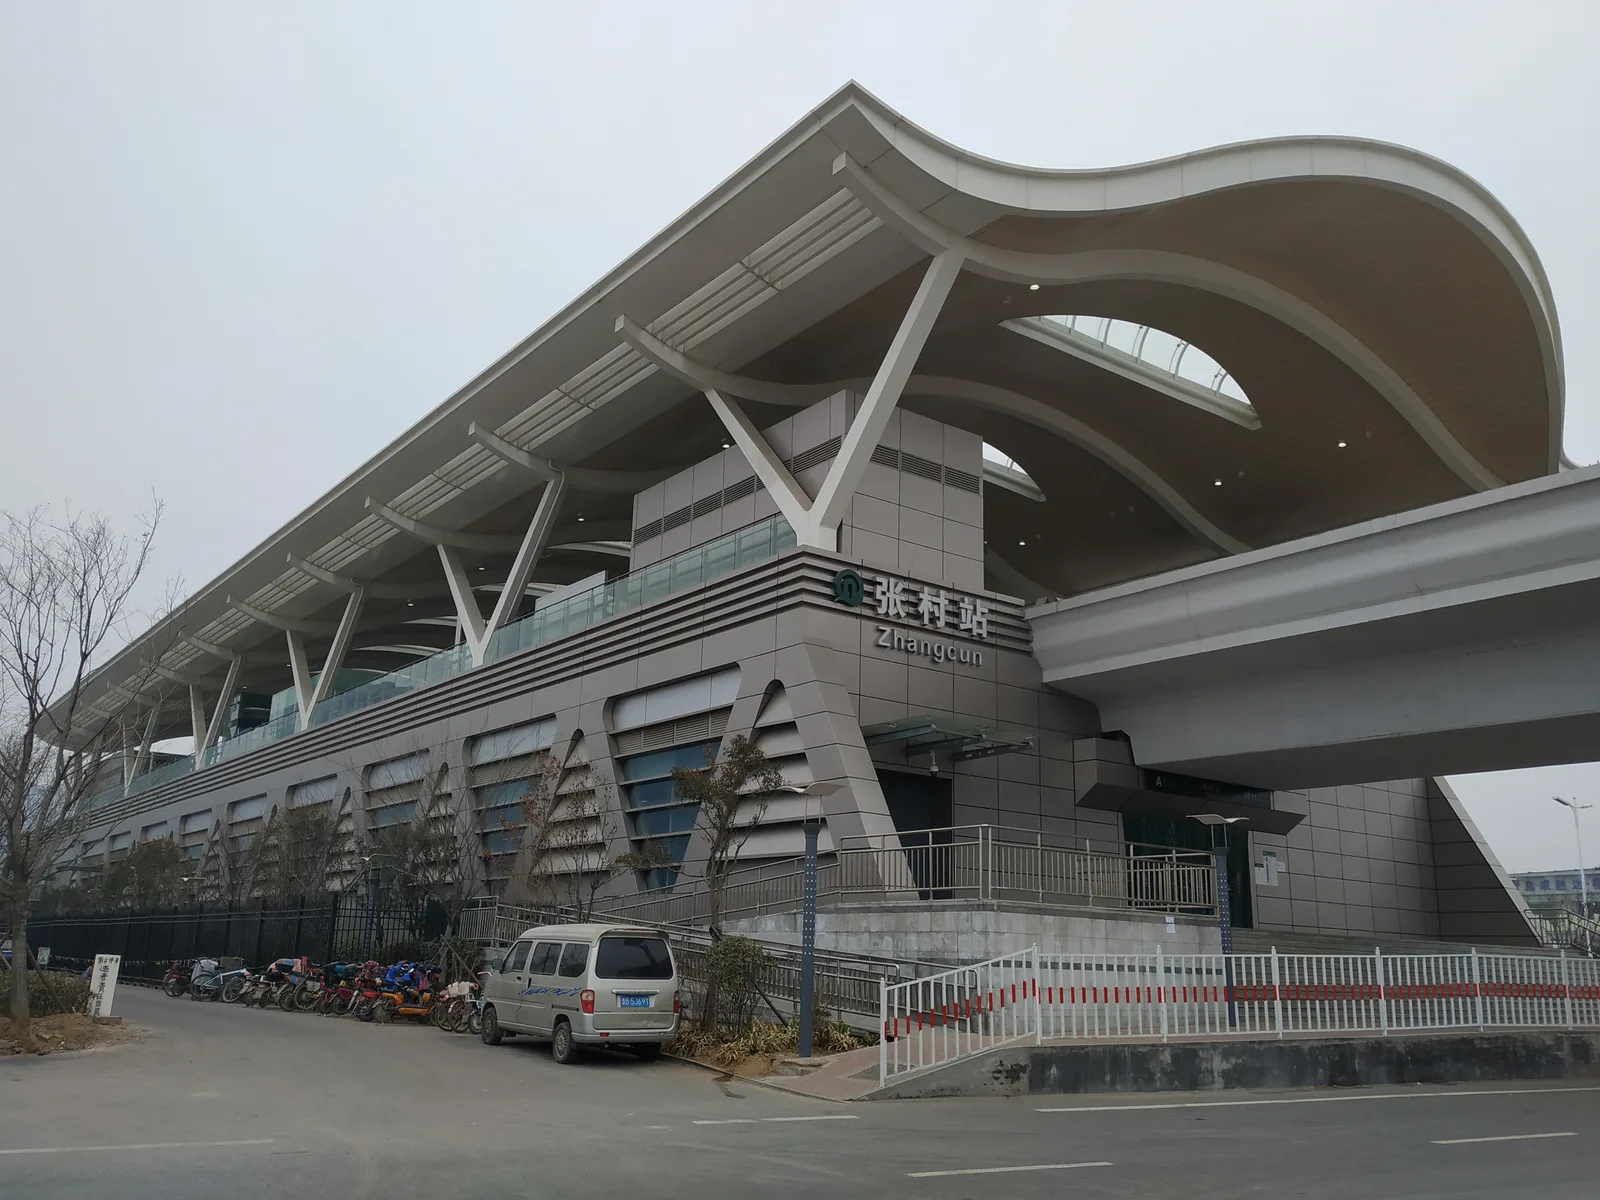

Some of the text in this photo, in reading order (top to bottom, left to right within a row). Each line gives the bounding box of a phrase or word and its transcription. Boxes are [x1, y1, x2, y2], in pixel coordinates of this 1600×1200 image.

[874, 576, 988, 638] 张村站
[876, 625, 983, 666] Zhangcun
[1155, 776, 1163, 788] A
